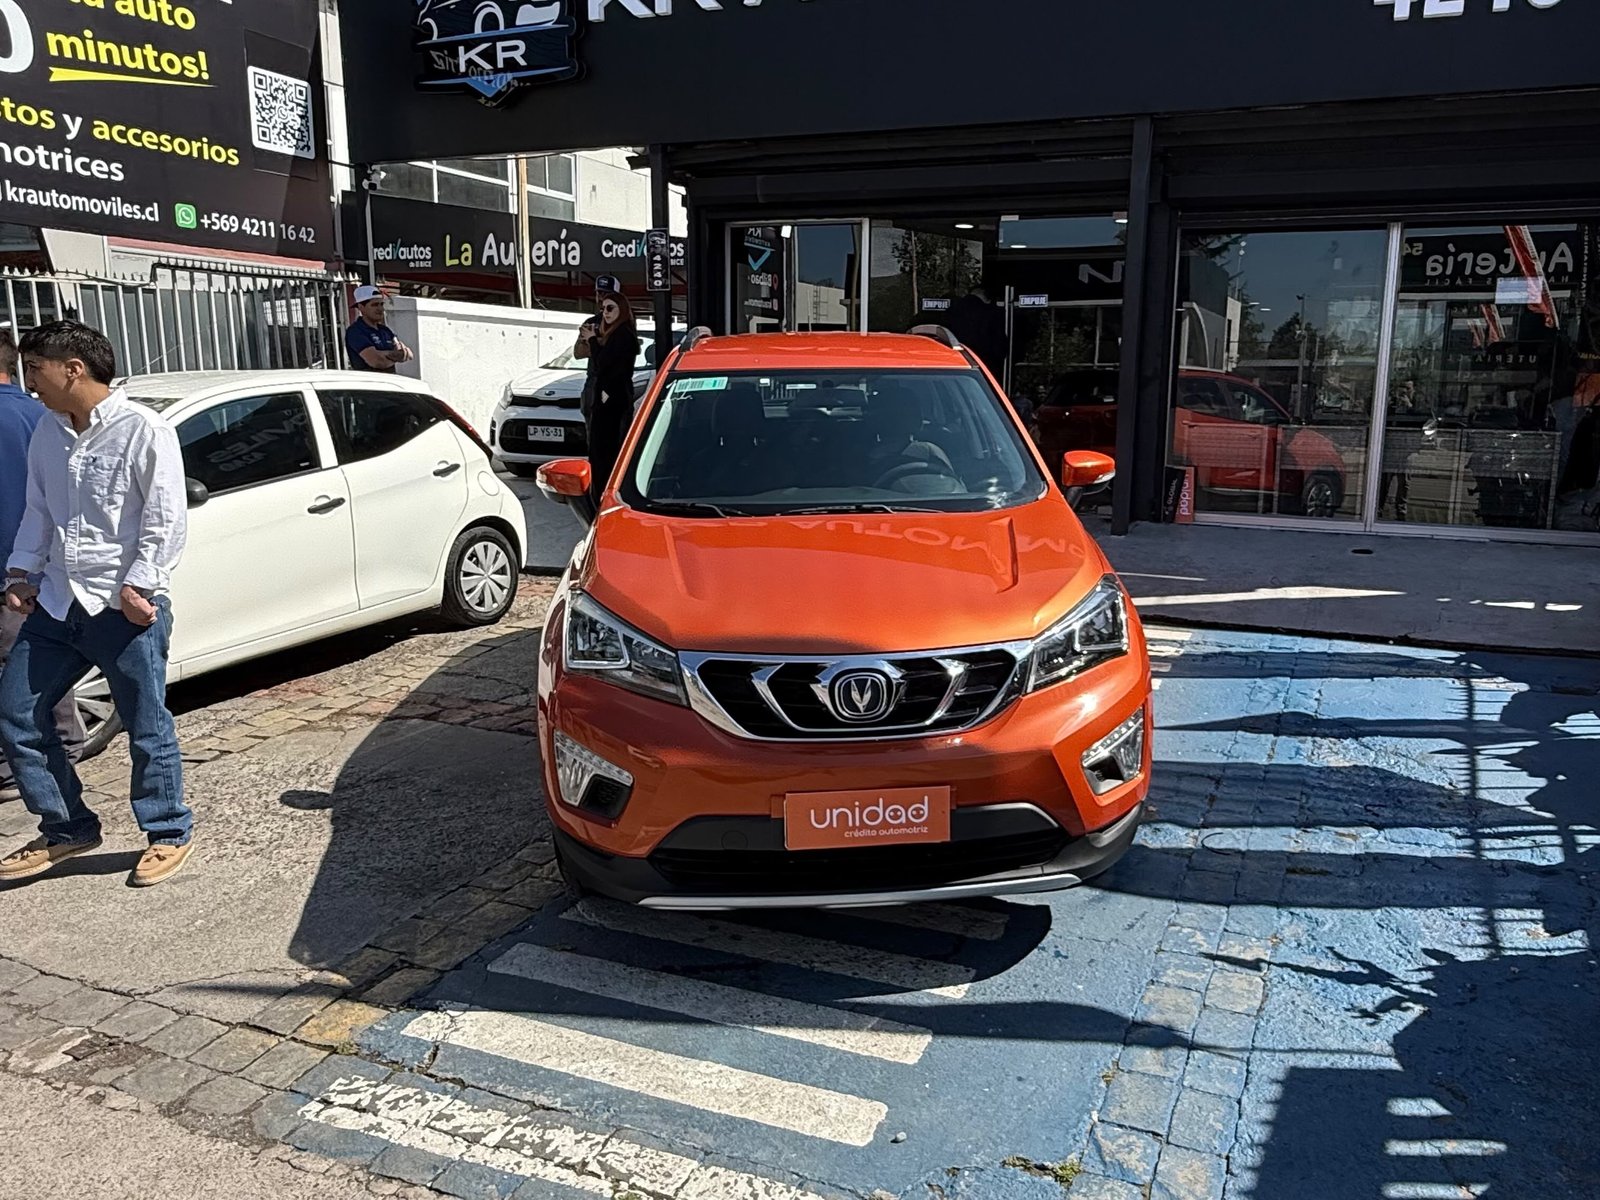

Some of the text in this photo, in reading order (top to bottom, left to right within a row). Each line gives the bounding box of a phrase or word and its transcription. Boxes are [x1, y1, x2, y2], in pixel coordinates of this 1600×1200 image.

[114, 0, 196, 31] auto
[46, 29, 210, 80] minutos!
[457, 39, 528, 73] KR
[0, 96, 241, 166] tos y accesorios
[4, 179, 160, 222] krautomoviles.cl
[200, 212, 316, 244] +569 4211 16 42
[445, 228, 581, 267] La Auería
[810, 795, 929, 829] unidad
[844, 826, 929, 838] crédito automotriz
